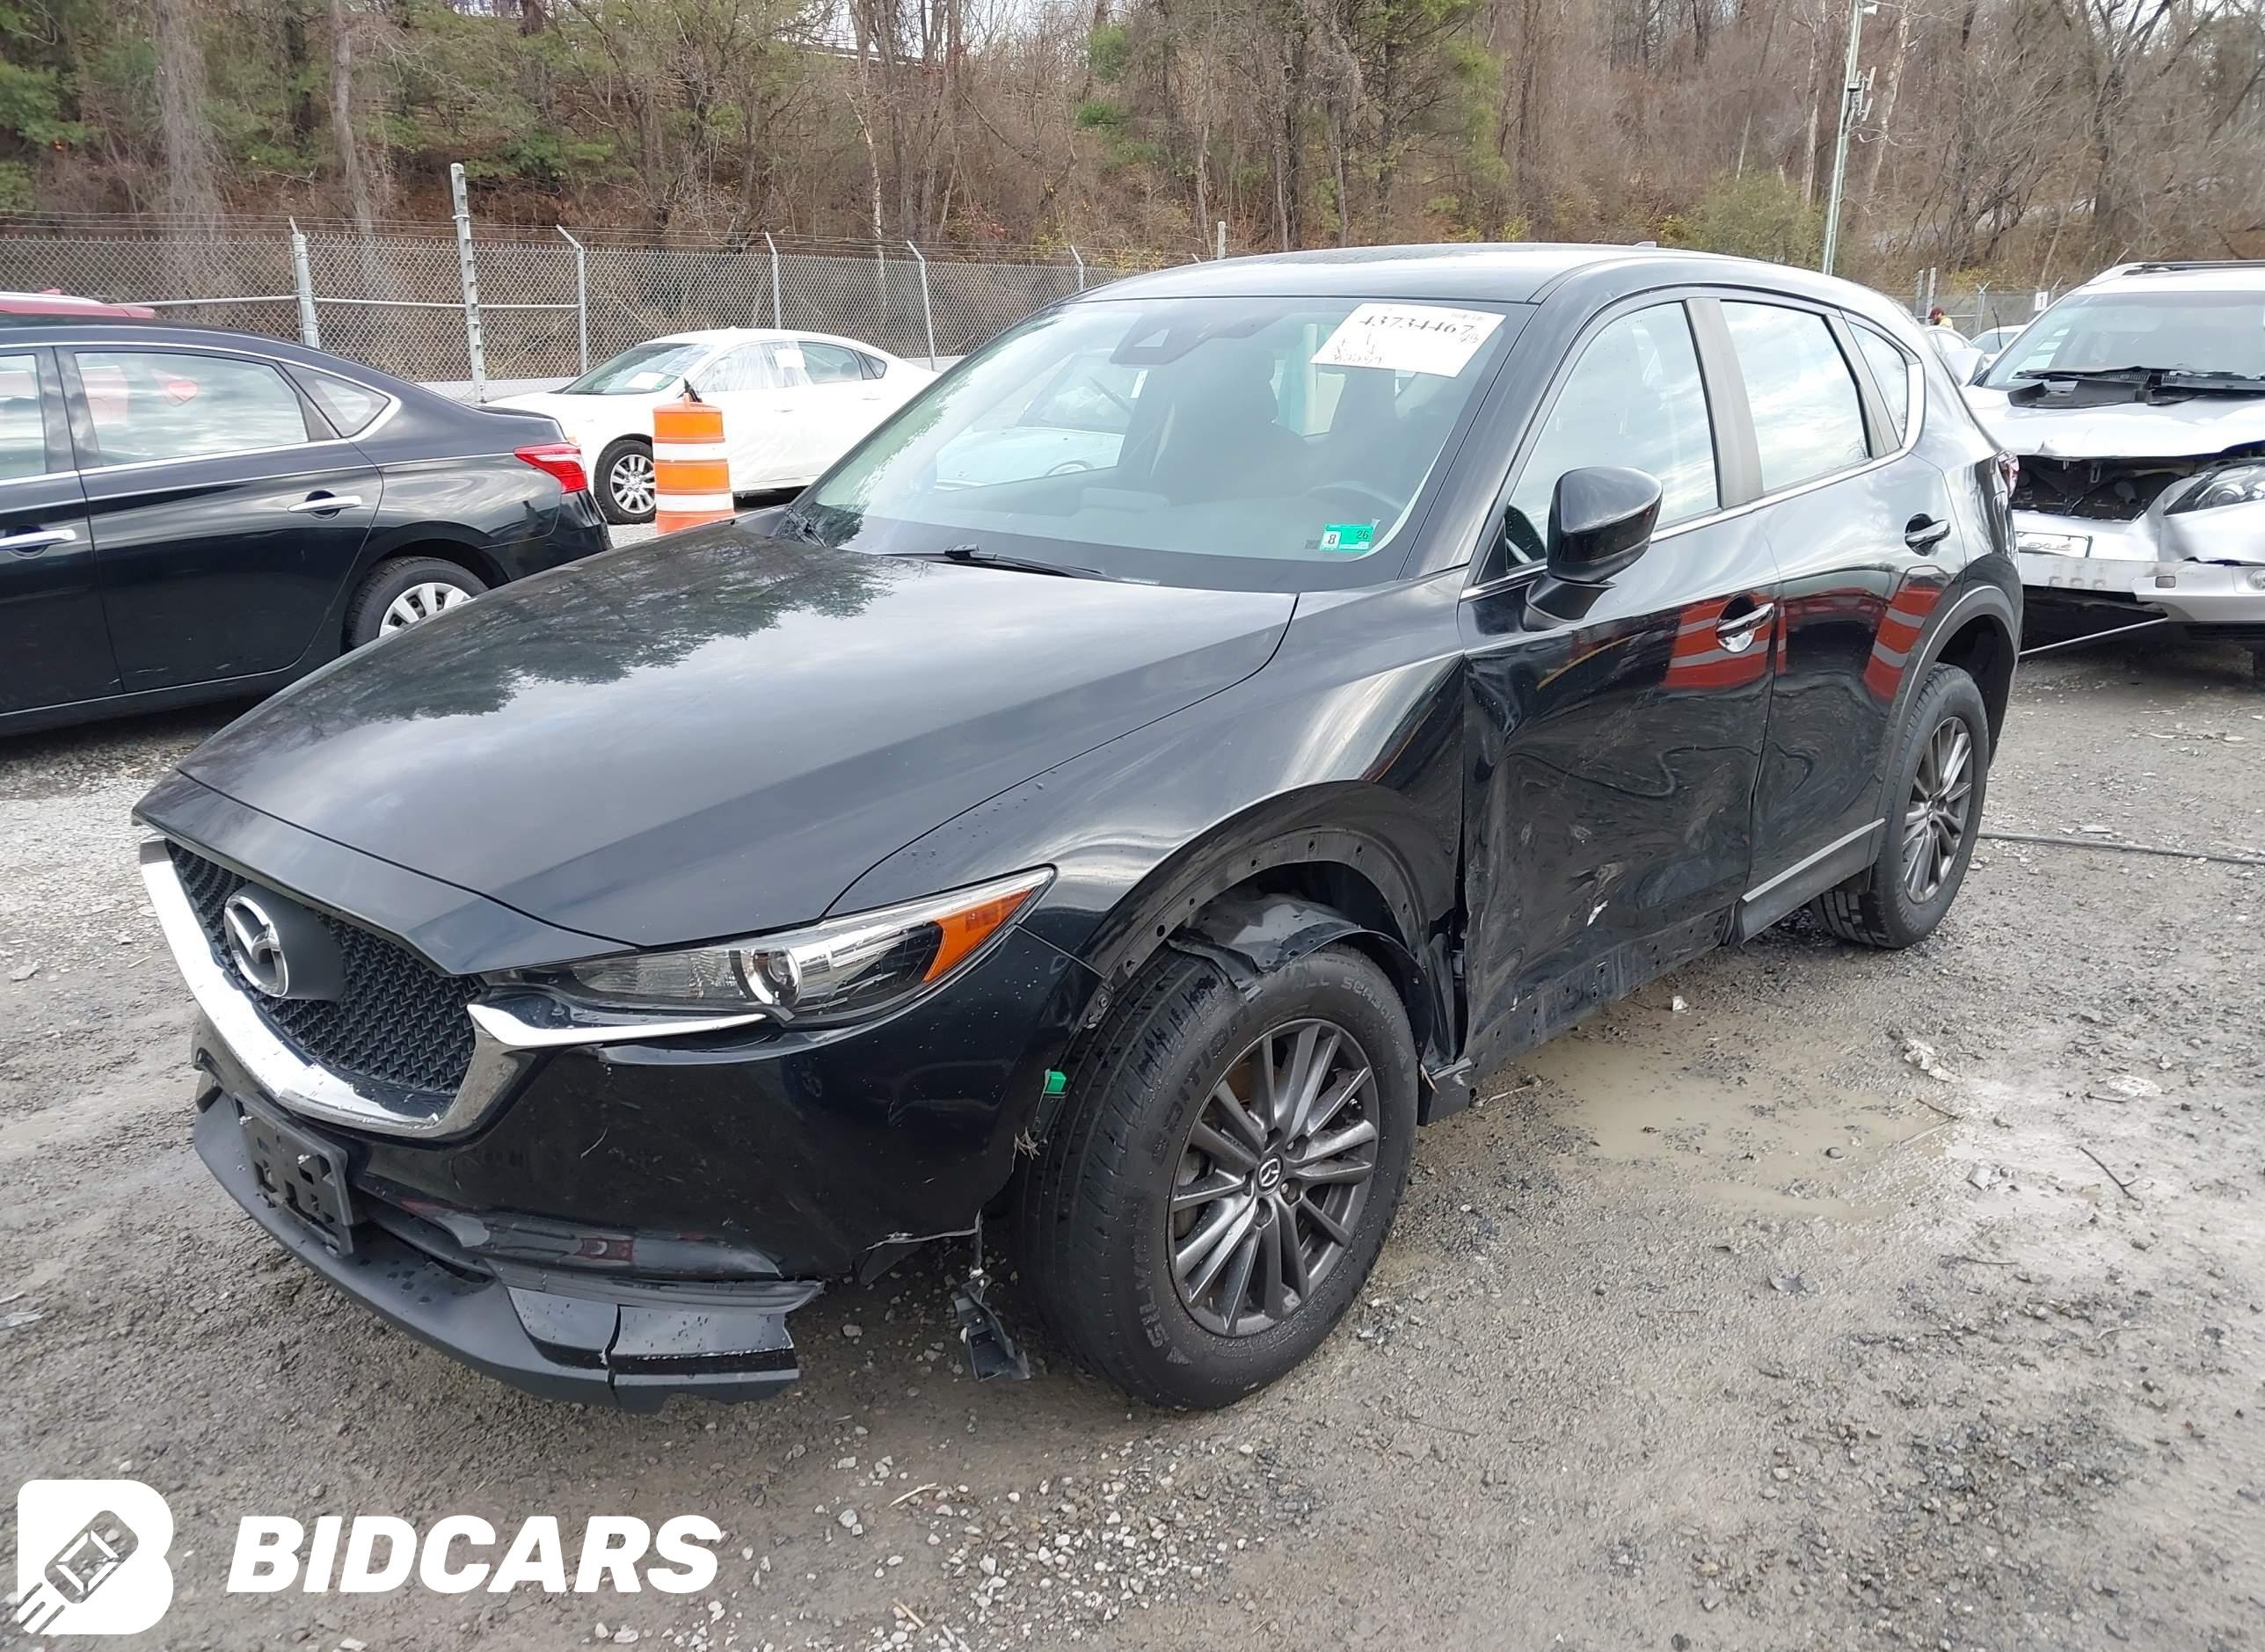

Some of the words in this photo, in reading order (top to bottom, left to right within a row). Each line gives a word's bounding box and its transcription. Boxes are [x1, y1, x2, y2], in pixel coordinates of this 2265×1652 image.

[1358, 315, 1477, 336] 43734467
[1328, 534, 1336, 544] 8
[1356, 530, 1369, 539] 26
